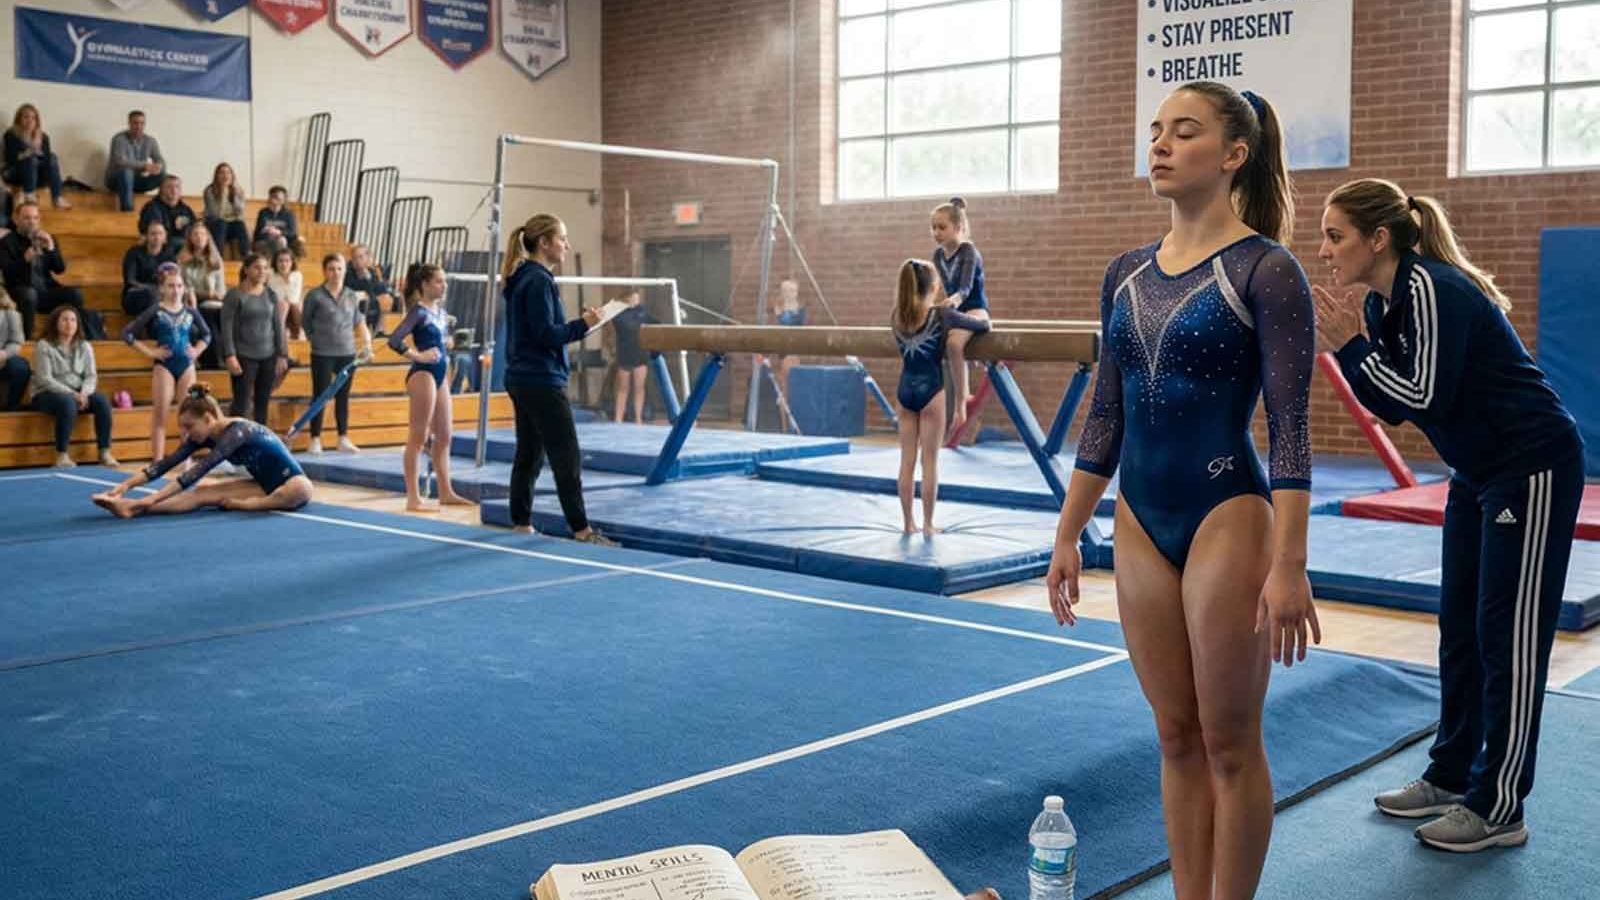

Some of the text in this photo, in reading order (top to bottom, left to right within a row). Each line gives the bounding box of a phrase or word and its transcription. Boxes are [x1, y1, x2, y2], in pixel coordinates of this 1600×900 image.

[1162, 11, 1294, 47] STAY PRESENT
[1162, 52, 1243, 83] BREATHE
[581, 863, 643, 882] MENTAL
